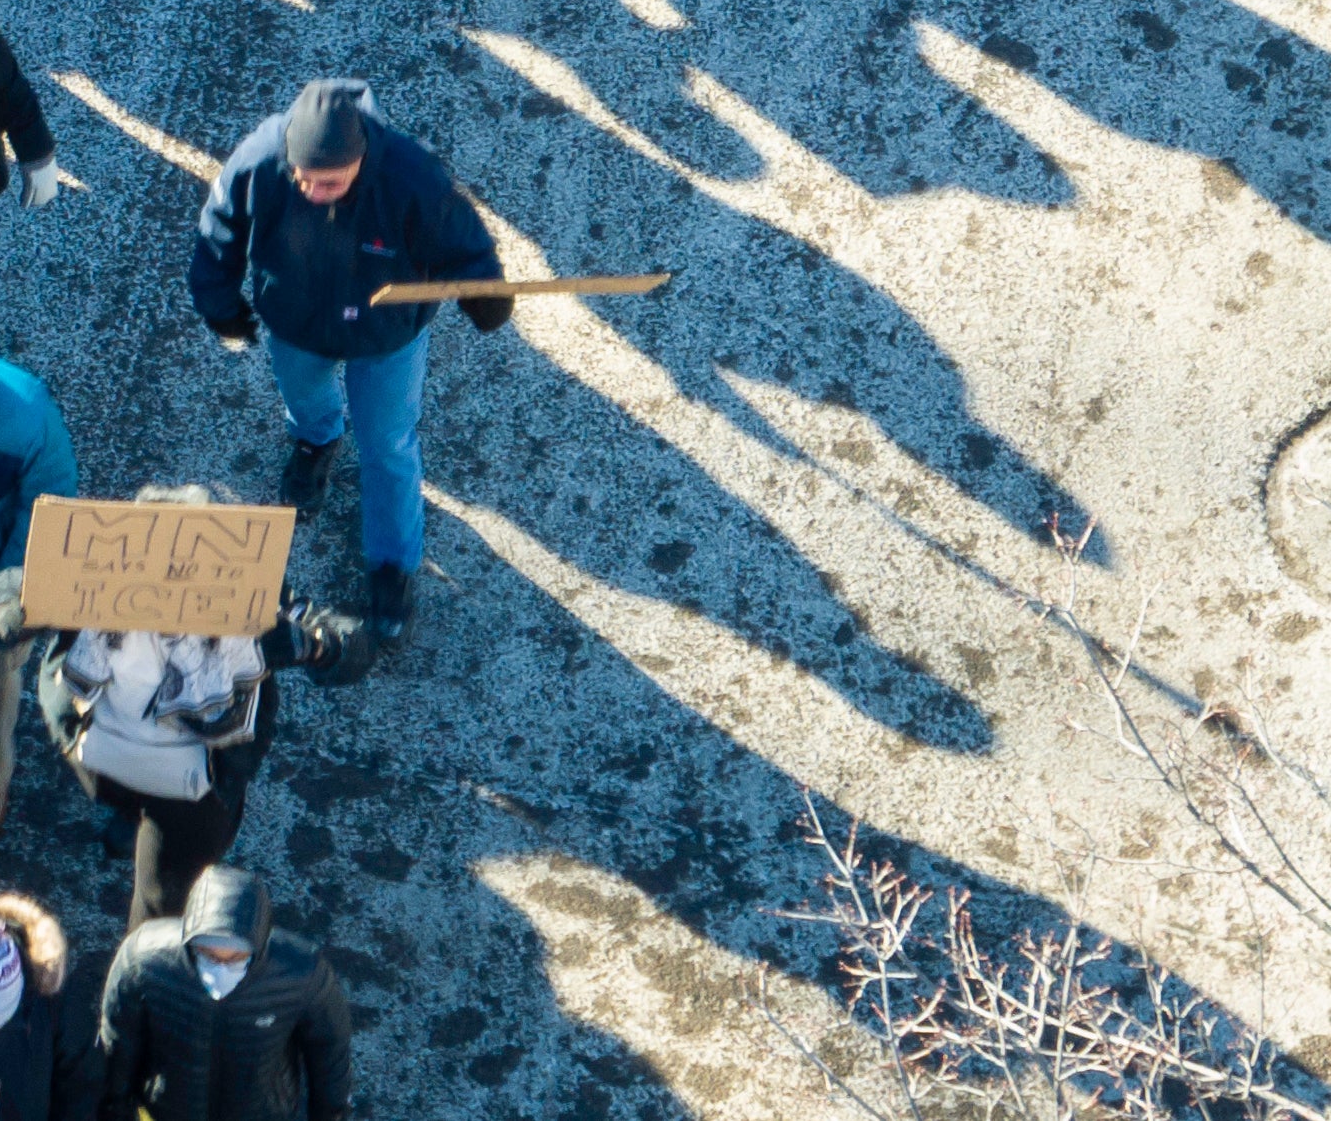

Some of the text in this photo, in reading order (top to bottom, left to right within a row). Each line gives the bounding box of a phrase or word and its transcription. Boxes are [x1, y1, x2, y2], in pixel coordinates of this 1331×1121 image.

[63, 509, 270, 564] MN
[167, 561, 199, 579] NO
[214, 565, 245, 578] TO
[72, 581, 268, 630] ICE!
